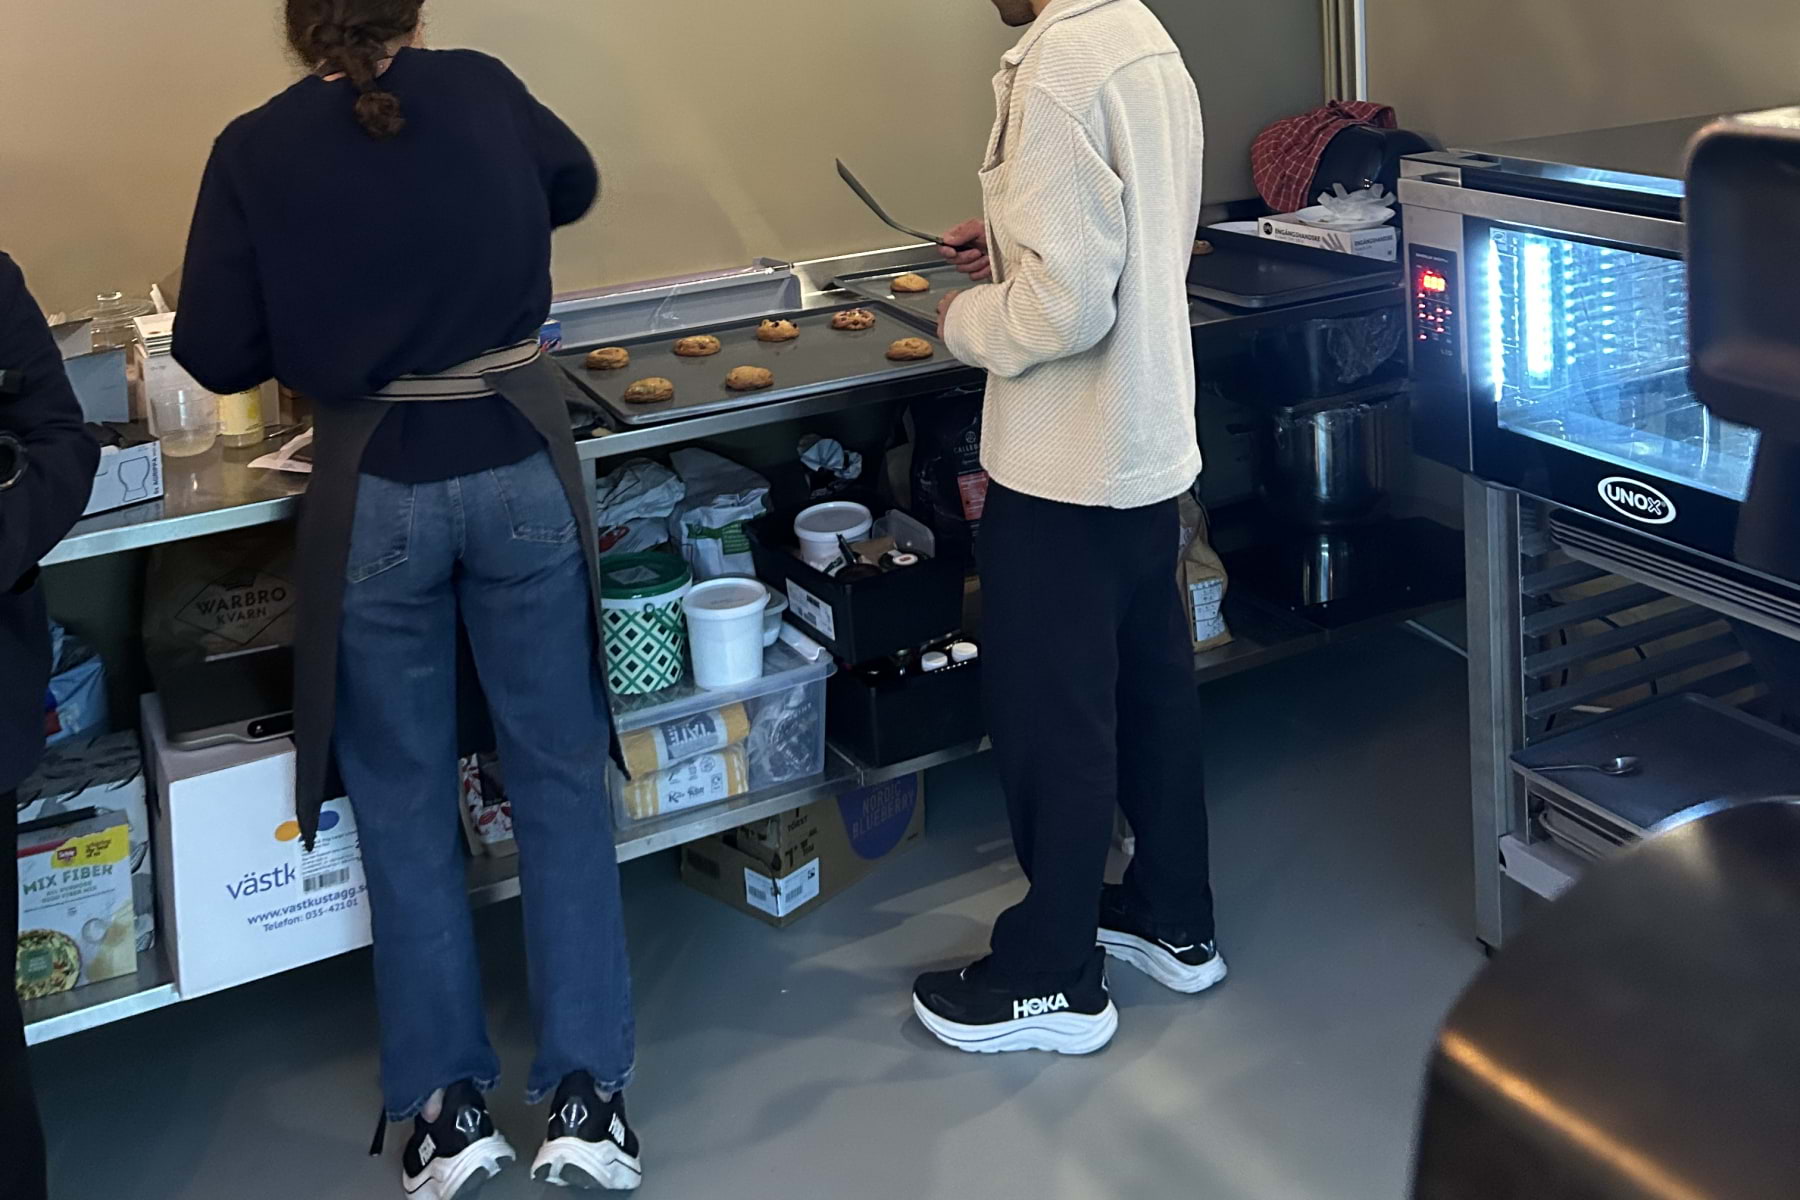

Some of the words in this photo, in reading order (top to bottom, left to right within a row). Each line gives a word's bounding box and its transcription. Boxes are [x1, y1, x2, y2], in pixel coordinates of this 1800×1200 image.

[1606, 483, 1662, 516] UNOX
[195, 587, 287, 615] WARBRO
[216, 607, 267, 625] KVARN
[863, 780, 901, 814] NORDIC
[852, 792, 914, 840] BLUEBERRY
[23, 874, 57, 896] MIX
[63, 865, 113, 883] FIBER
[263, 916, 303, 932] Telefon:
[1013, 992, 1070, 1019] HOKA
